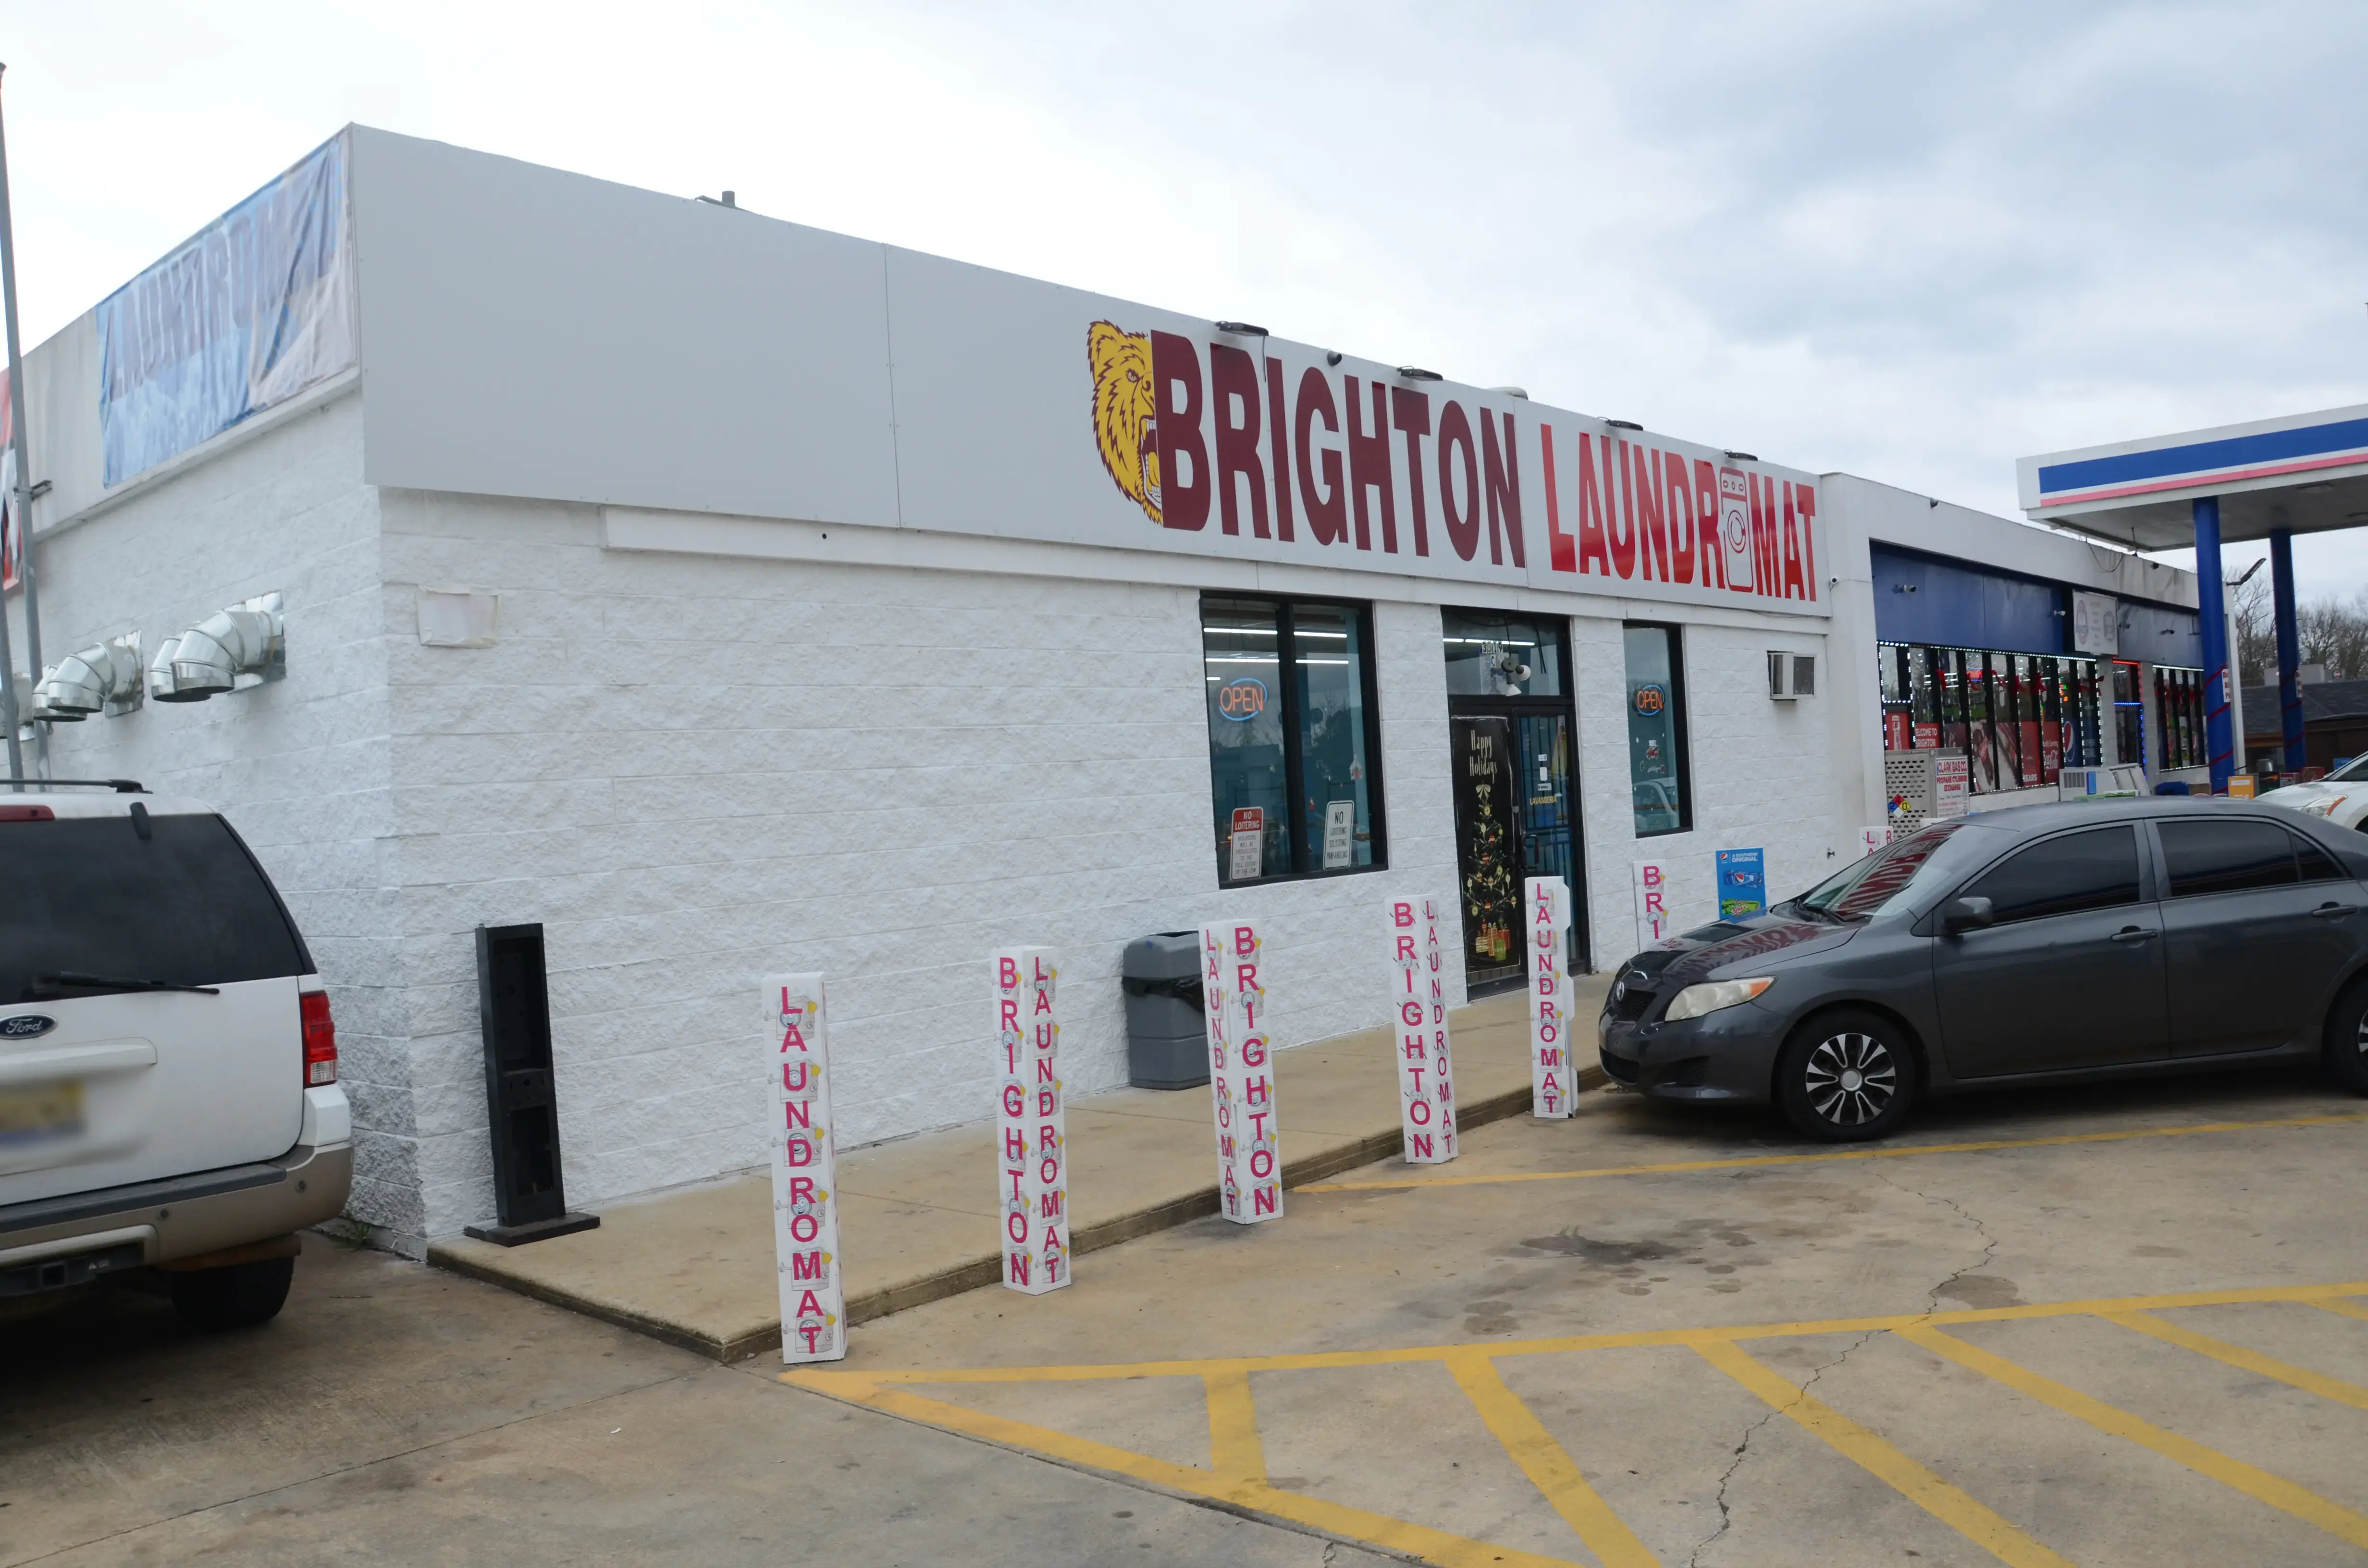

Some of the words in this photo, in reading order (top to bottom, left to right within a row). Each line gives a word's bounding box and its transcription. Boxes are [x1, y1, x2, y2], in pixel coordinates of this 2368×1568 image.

[1151, 330, 1525, 568] BRIGHTON
[1220, 687, 1263, 711] OPEN
[1637, 690, 1663, 709] OPEN
[1471, 730, 1492, 759] Happy
[1916, 739, 1936, 747] RIGHTON
[1469, 755, 1497, 784] Holidays
[1952, 761, 1960, 772] GAS
[1530, 796, 1557, 805] LAVANDERIA
[1902, 802, 1908, 810] 0
[1235, 821, 1259, 830] LOITERING
[1243, 811, 1252, 820] NO
[1334, 811, 1344, 824] NO
[1536, 883, 1558, 1114] LAUNDROMAT
[6, 1018, 42, 1034] Ford
[1394, 903, 1432, 1158] BRIGHTON
[1426, 901, 1452, 1153] LAUNDROMAT
[1206, 929, 1235, 1215] LAUNDROMAT
[1235, 927, 1274, 1216] BRIGHTON
[1000, 957, 1028, 1286] BRIGHTON
[1035, 956, 1061, 1283] LAUNDROMAT
[780, 986, 825, 1354] LAUNDROMAT
